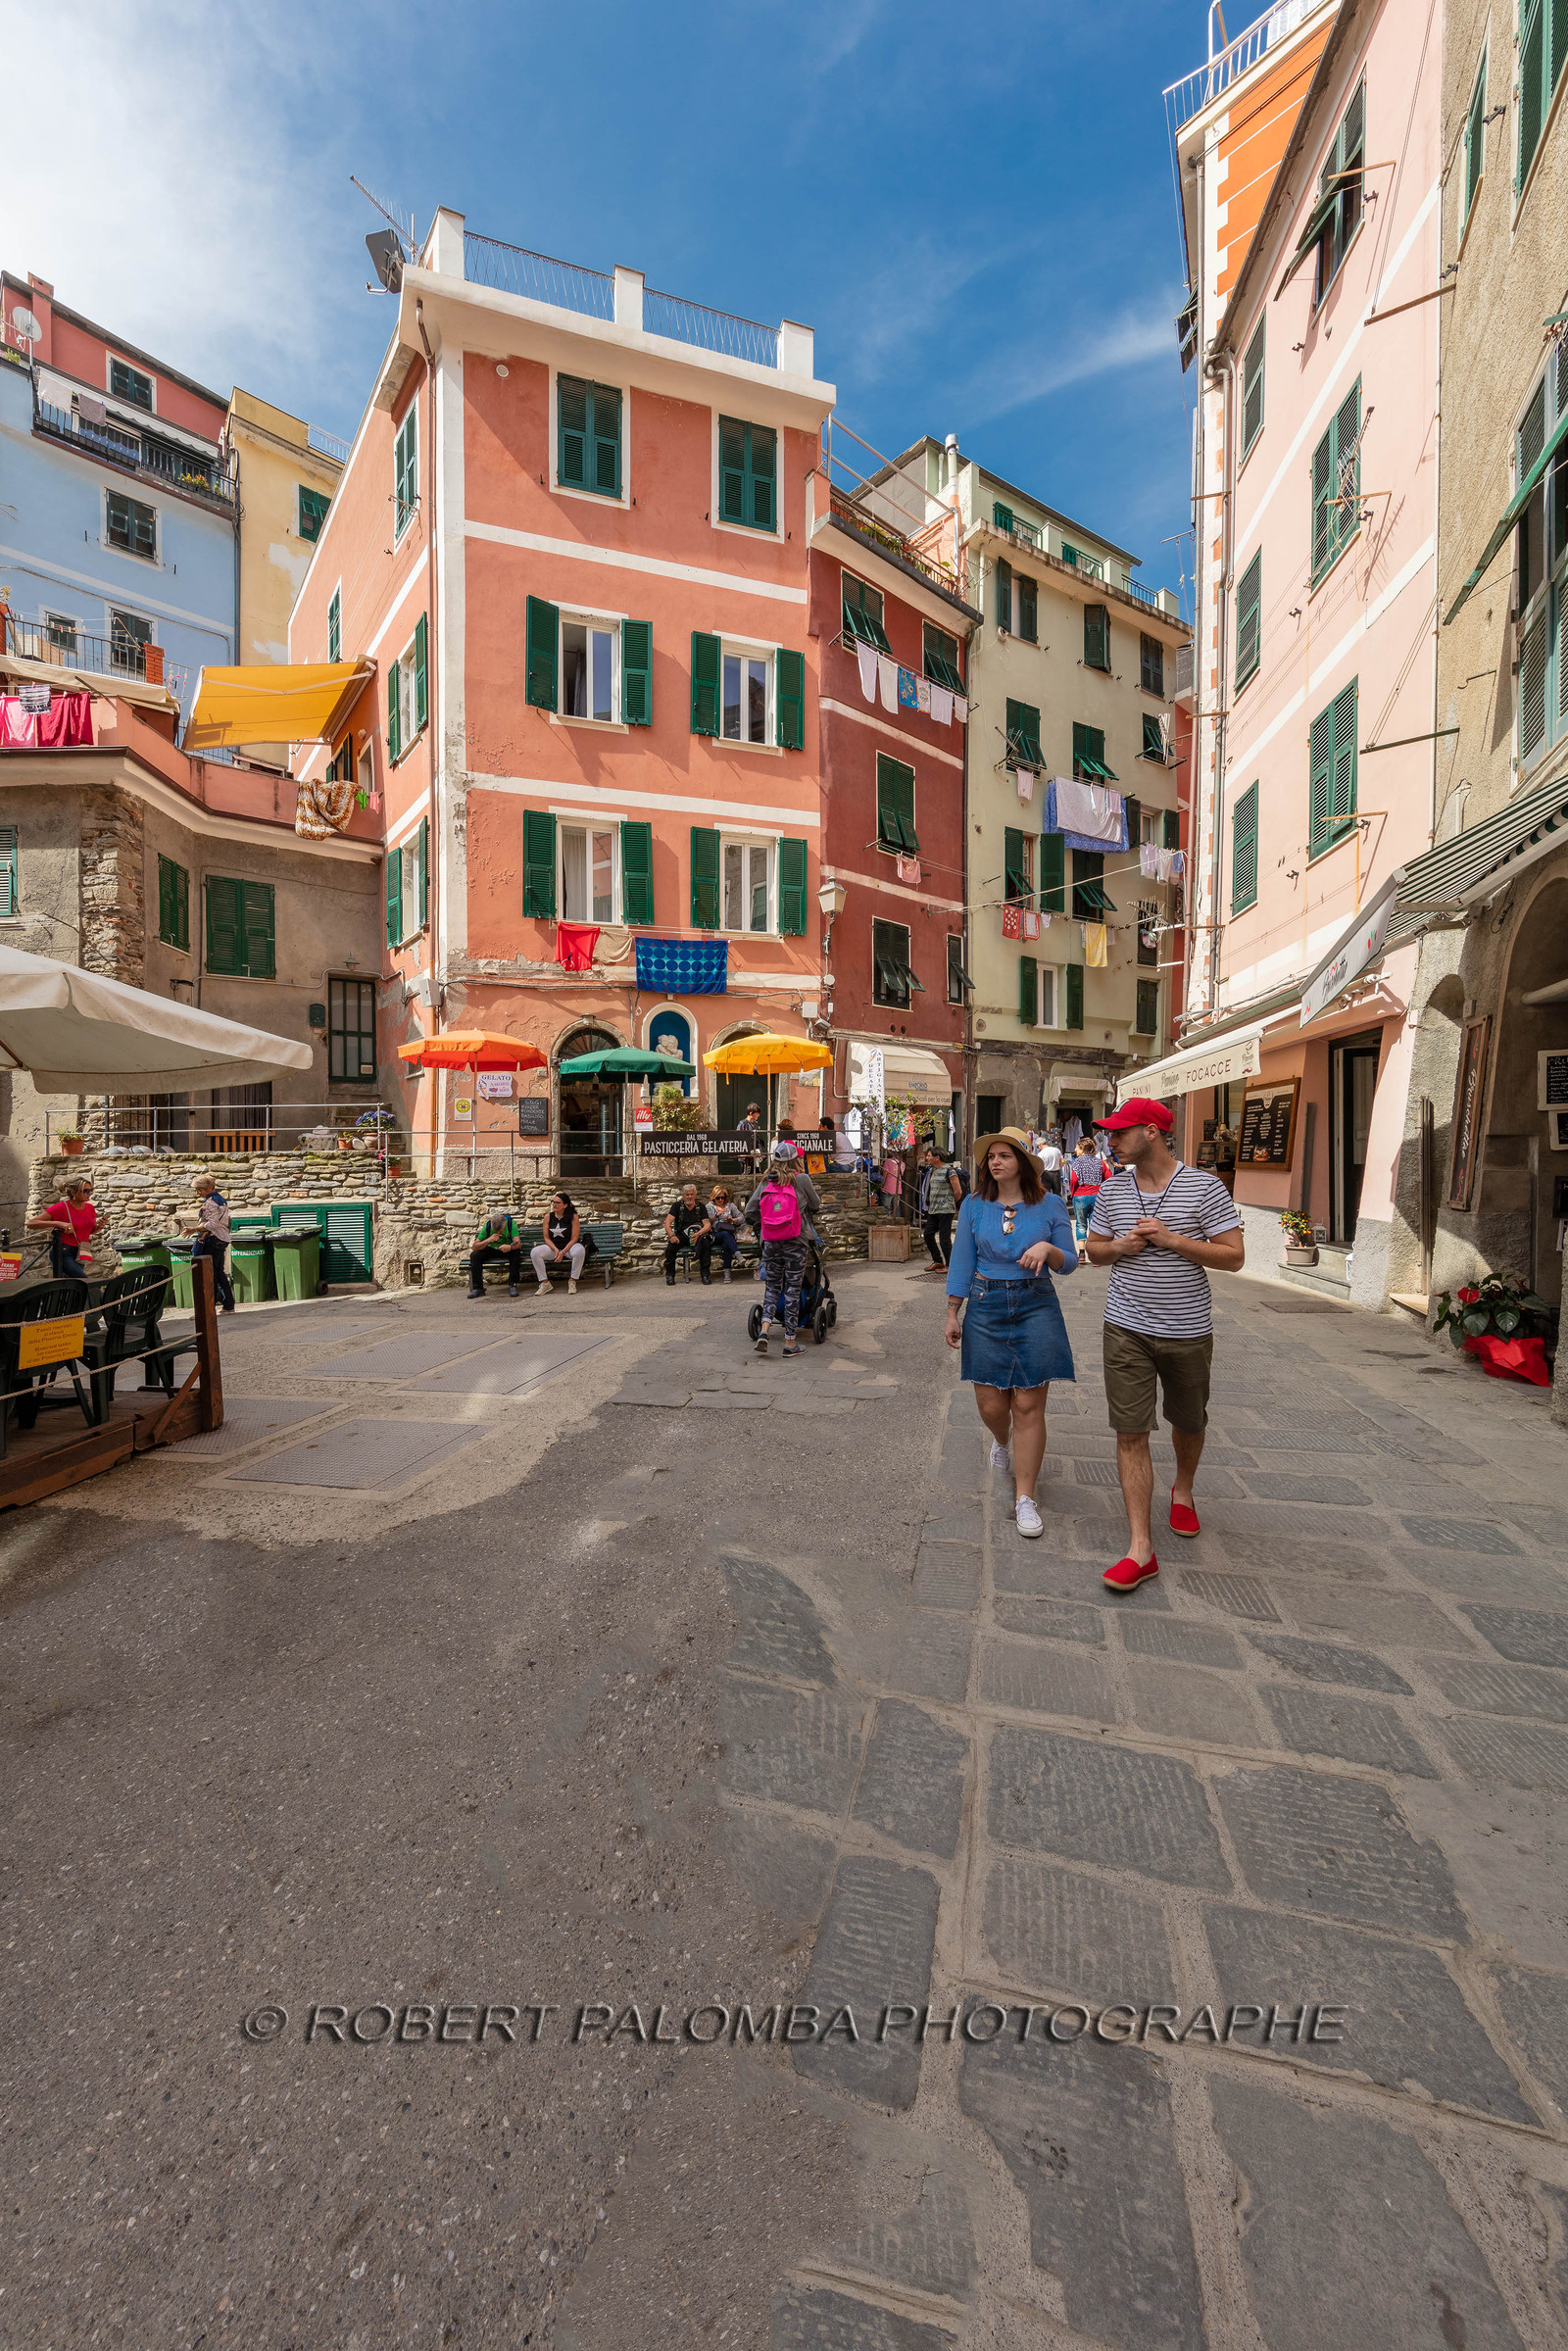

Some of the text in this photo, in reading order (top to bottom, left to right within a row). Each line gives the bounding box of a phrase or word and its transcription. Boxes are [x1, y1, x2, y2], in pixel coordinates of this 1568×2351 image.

[1186, 1058, 1232, 1084] FOCACCE
[1132, 1083, 1151, 1097] PANINI
[636, 1109, 651, 1122] illy
[644, 1141, 749, 1153] PASTICCERIA GELATERIA
[792, 1139, 833, 1151] TIGIANALE
